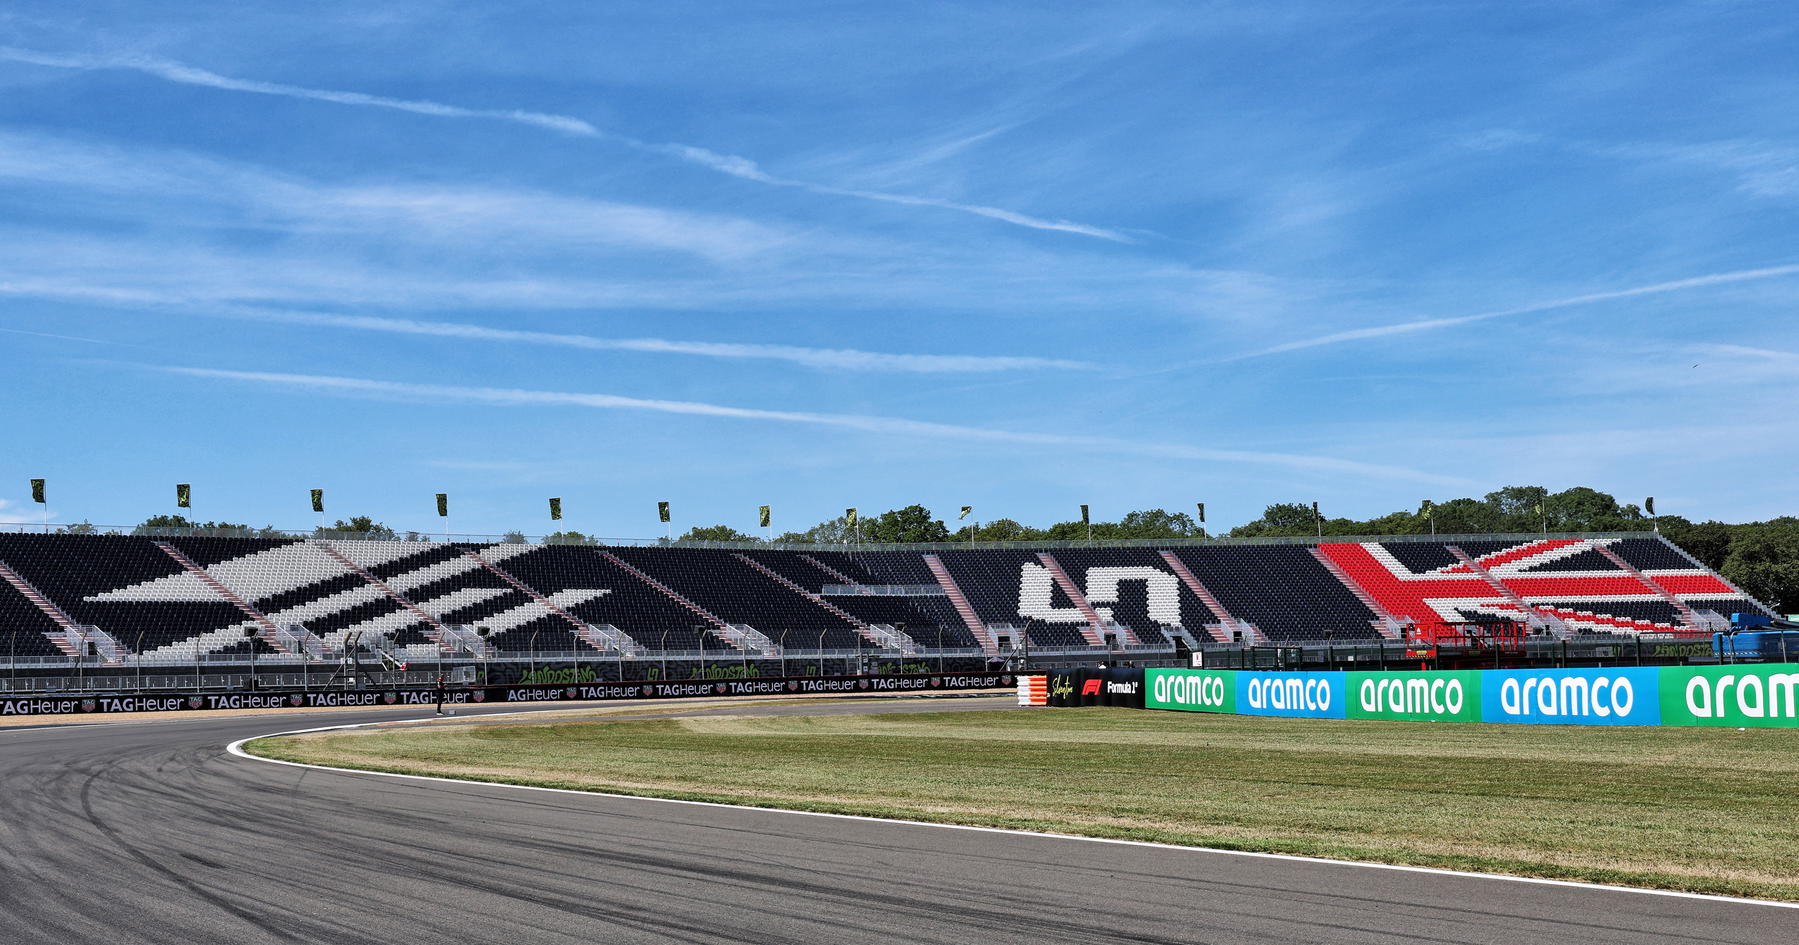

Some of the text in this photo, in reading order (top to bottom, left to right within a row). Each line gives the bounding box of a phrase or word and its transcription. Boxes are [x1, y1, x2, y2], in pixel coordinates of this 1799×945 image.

[1107, 681, 1131, 694] Formula
[1154, 675, 1224, 706] aramco
[1248, 678, 1331, 711] aramco
[1360, 678, 1463, 715] aramco
[1500, 676, 1634, 717] aramco
